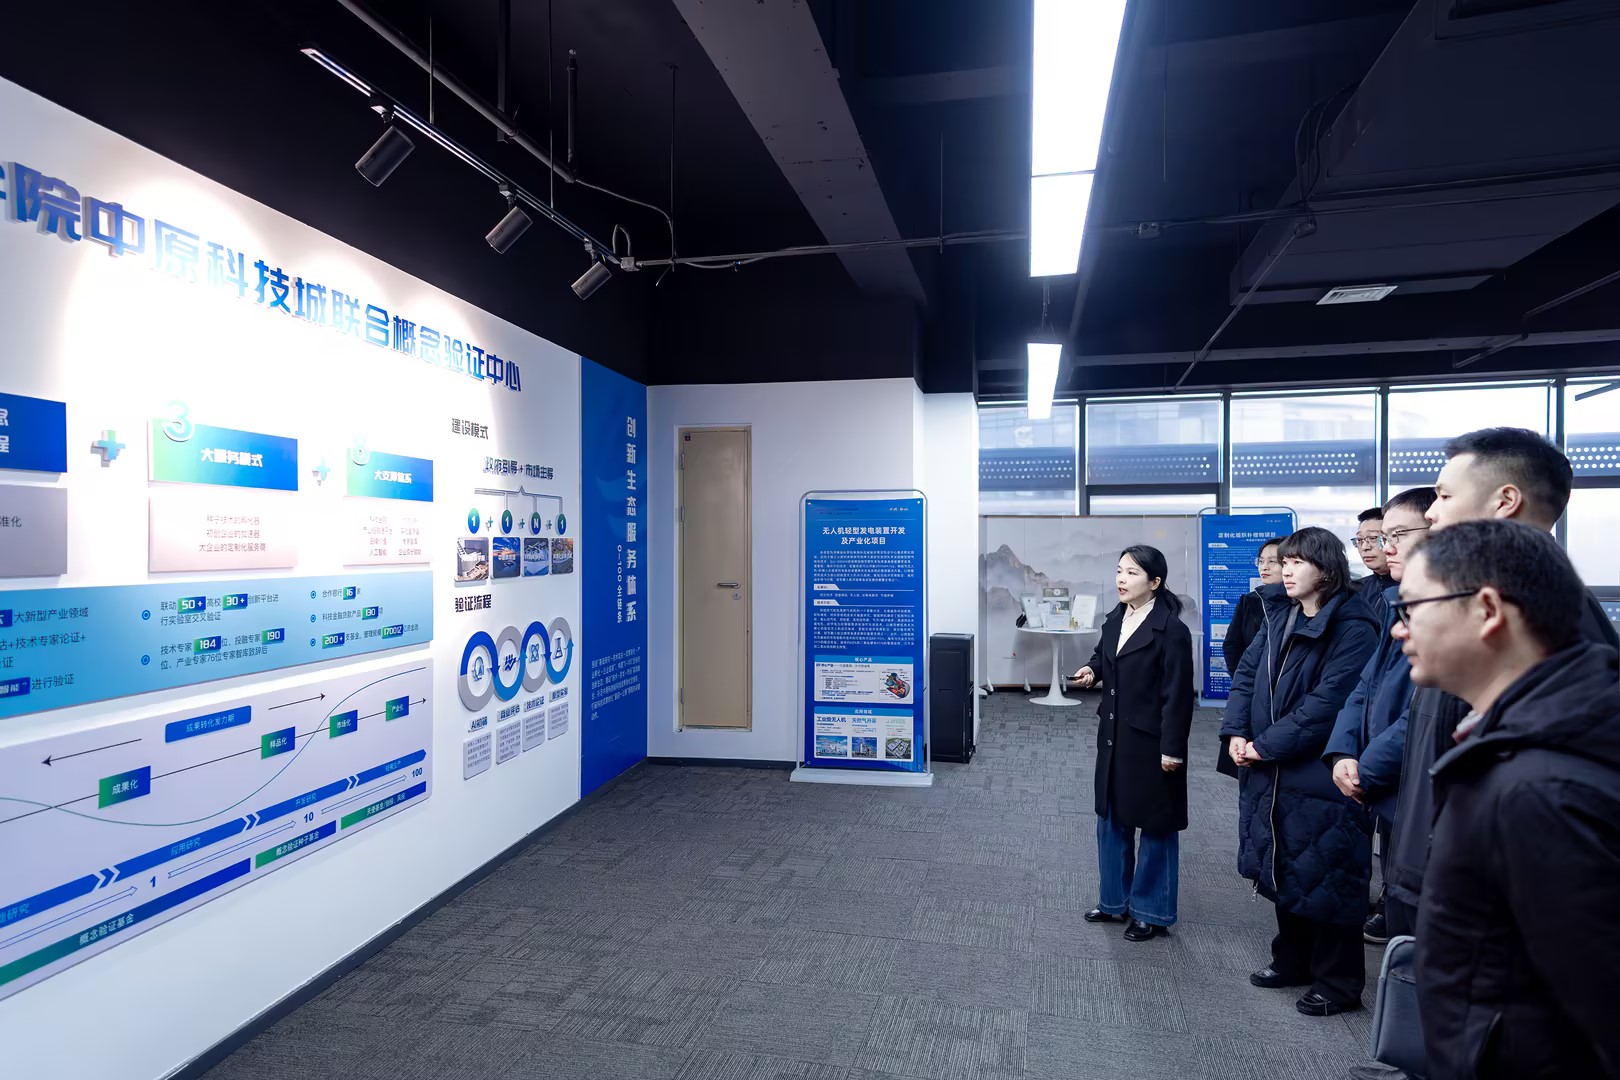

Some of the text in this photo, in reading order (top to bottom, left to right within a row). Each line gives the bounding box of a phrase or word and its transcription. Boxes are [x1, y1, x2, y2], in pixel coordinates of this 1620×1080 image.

[0, 162, 521, 391] 院中原科技城联合概念验证中心
[452, 418, 488, 439] 建设模式
[626, 416, 636, 622] 创新生态服务体系
[822, 527, 906, 535] 无人机轻型发电装置开发
[841, 537, 886, 545] 及产业化项目
[455, 594, 492, 612] 验证流程
[160, 611, 221, 627] 行实验室交叉验证
[0, 656, 13, 668] 证
[336, 719, 351, 729] 市场化
[269, 737, 287, 749] 样品化
[412, 767, 423, 778] 100
[112, 779, 138, 795] 成果化
[304, 811, 314, 823] 10
[170, 837, 200, 856] 应用研究
[276, 831, 319, 857] 概念验证种子基金
[150, 876, 156, 887] 1
[79, 913, 134, 945] 概念验证基金
